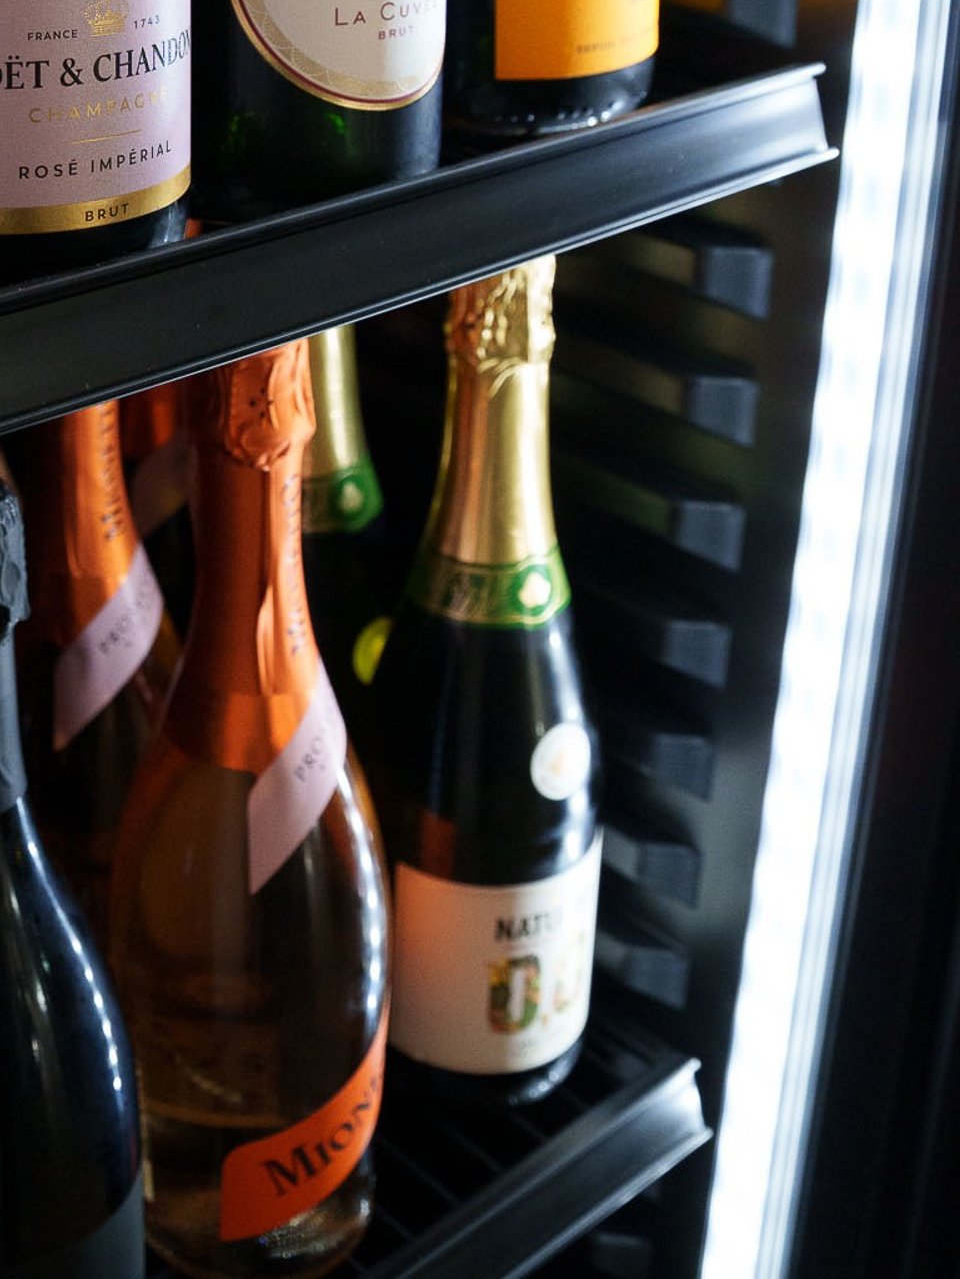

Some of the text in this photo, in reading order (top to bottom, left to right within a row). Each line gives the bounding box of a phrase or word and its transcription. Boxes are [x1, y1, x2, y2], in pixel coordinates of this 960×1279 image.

[27, 14, 160, 41] FRANCE 1743
[378, 26, 415, 40] BRUT
[59, 57, 84, 86] &
[18, 139, 172, 180] ROSÉ IMPÉRIAL
[85, 202, 130, 222] BRUT
